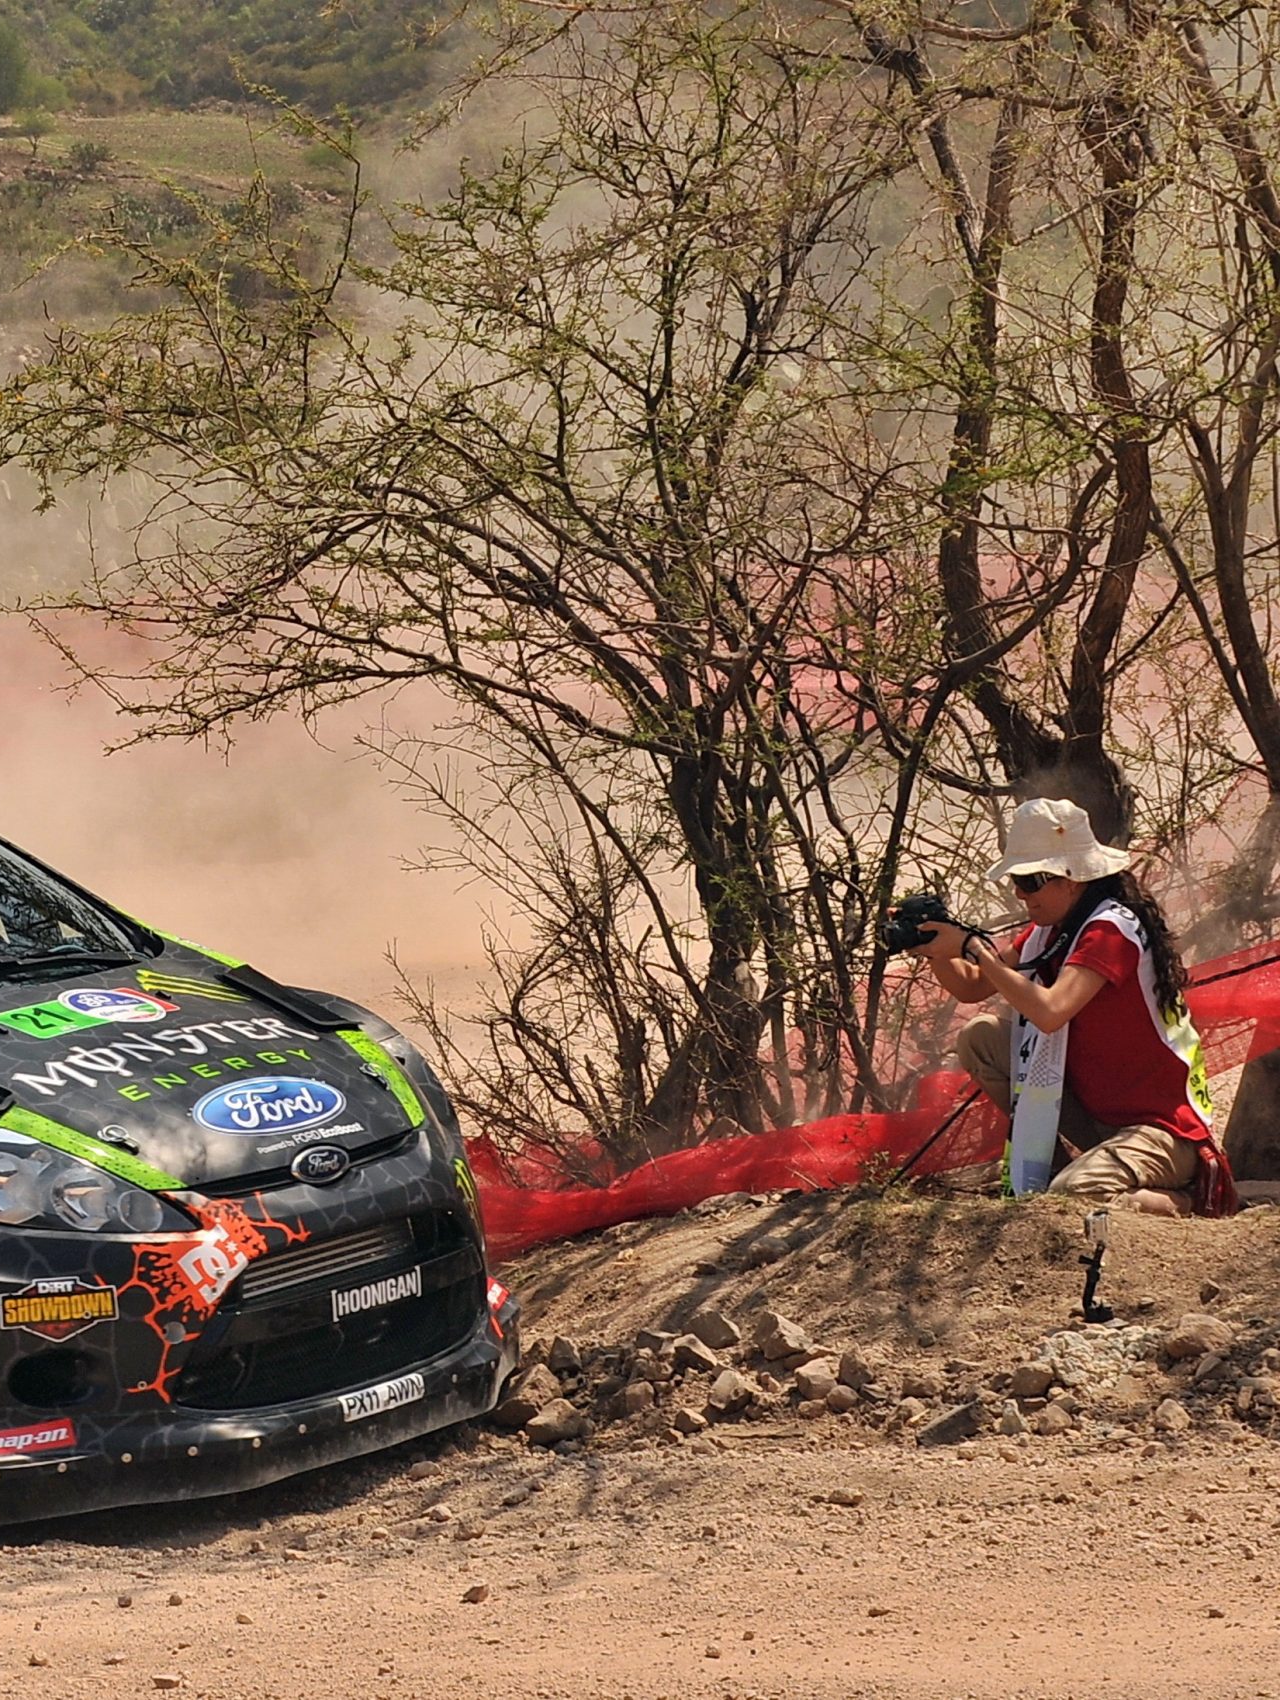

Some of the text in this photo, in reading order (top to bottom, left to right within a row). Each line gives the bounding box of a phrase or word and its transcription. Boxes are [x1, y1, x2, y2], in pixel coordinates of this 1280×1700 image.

[10, 1007, 74, 1030] 21
[118, 1048, 312, 1102] ENERGY
[223, 1084, 323, 1128] Ford
[292, 1130, 322, 1144] FORD
[308, 1151, 340, 1175] Ford
[345, 1375, 423, 1415] PX11 AWN
